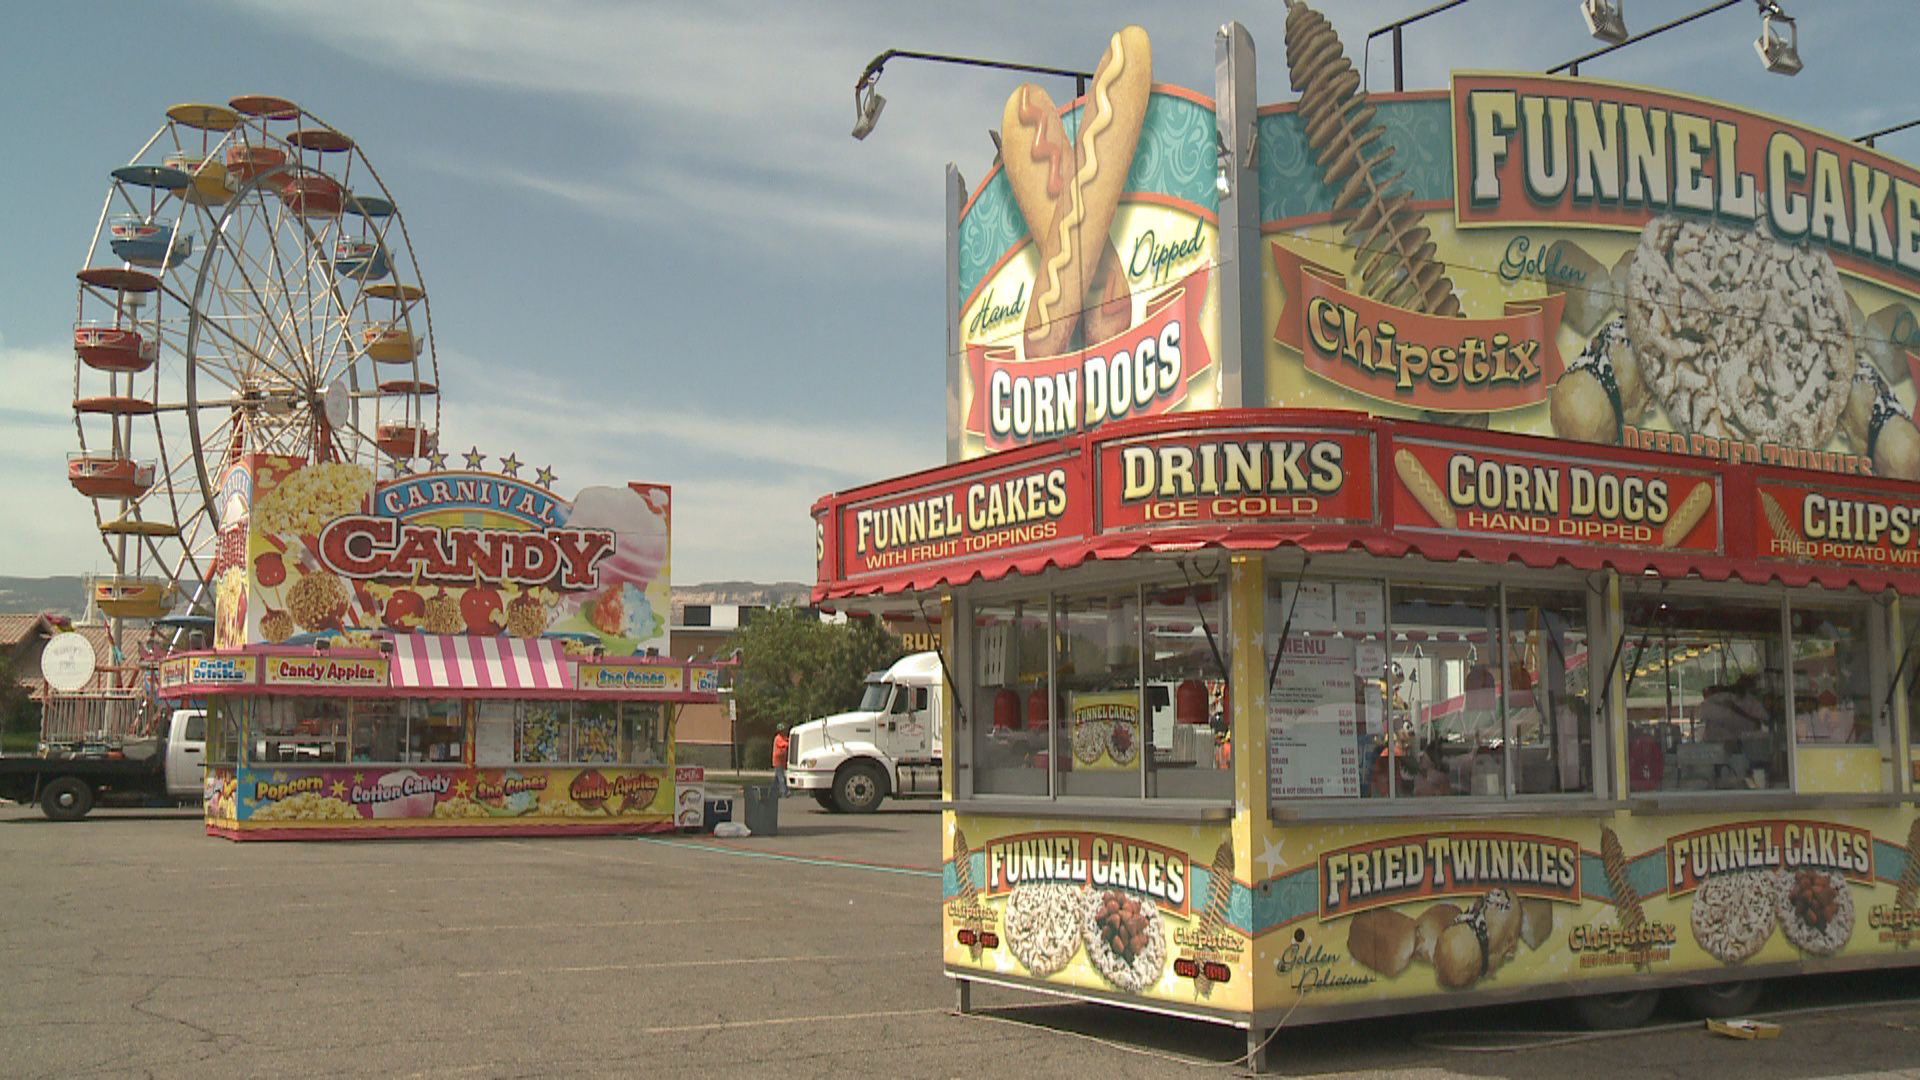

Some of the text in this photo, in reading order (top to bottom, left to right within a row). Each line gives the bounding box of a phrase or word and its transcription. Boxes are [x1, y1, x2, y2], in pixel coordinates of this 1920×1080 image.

[1470, 88, 1757, 221] FUNNEL
[1129, 216, 1205, 282] Dipped
[1500, 235, 1586, 281] Golden
[970, 282, 1025, 332] Hand
[1308, 298, 1542, 390] Chipstix
[991, 320, 1181, 437] CORN DOGS
[1123, 441, 1344, 501] DRINKS
[1449, 455, 1669, 523] CORN DOGS
[384, 480, 556, 526] CARNIVAL
[857, 494, 962, 553] FUNNEL
[967, 469, 1067, 532] CAKES
[1144, 497, 1319, 521] ICE COLD
[866, 522, 1057, 570] WITH FRUIT TOPPINGS
[1468, 512, 1652, 541] HAND DIPPED
[319, 514, 616, 590] CANDY
[1771, 539, 1818, 557] FRIED
[1823, 543, 1886, 561] POTATO
[1279, 639, 1326, 655] MENU
[279, 661, 375, 681] Candy Apples
[599, 669, 624, 685] Sno
[1076, 704, 1136, 724] FUNNEL CAKES
[255, 775, 324, 801] Popcorn
[351, 773, 452, 805] Cotton Candy
[476, 775, 548, 799] Sno Cones
[570, 782, 613, 801] Candy
[613, 775, 660, 795] Apples
[989, 836, 1186, 904] FUNNEL CAKES
[1328, 836, 1576, 906] FRIED TWINKIES
[1672, 823, 1869, 886] FUNNEL CAKES
[1278, 943, 1341, 973] Golden
[1569, 921, 1676, 953] Chipstix
